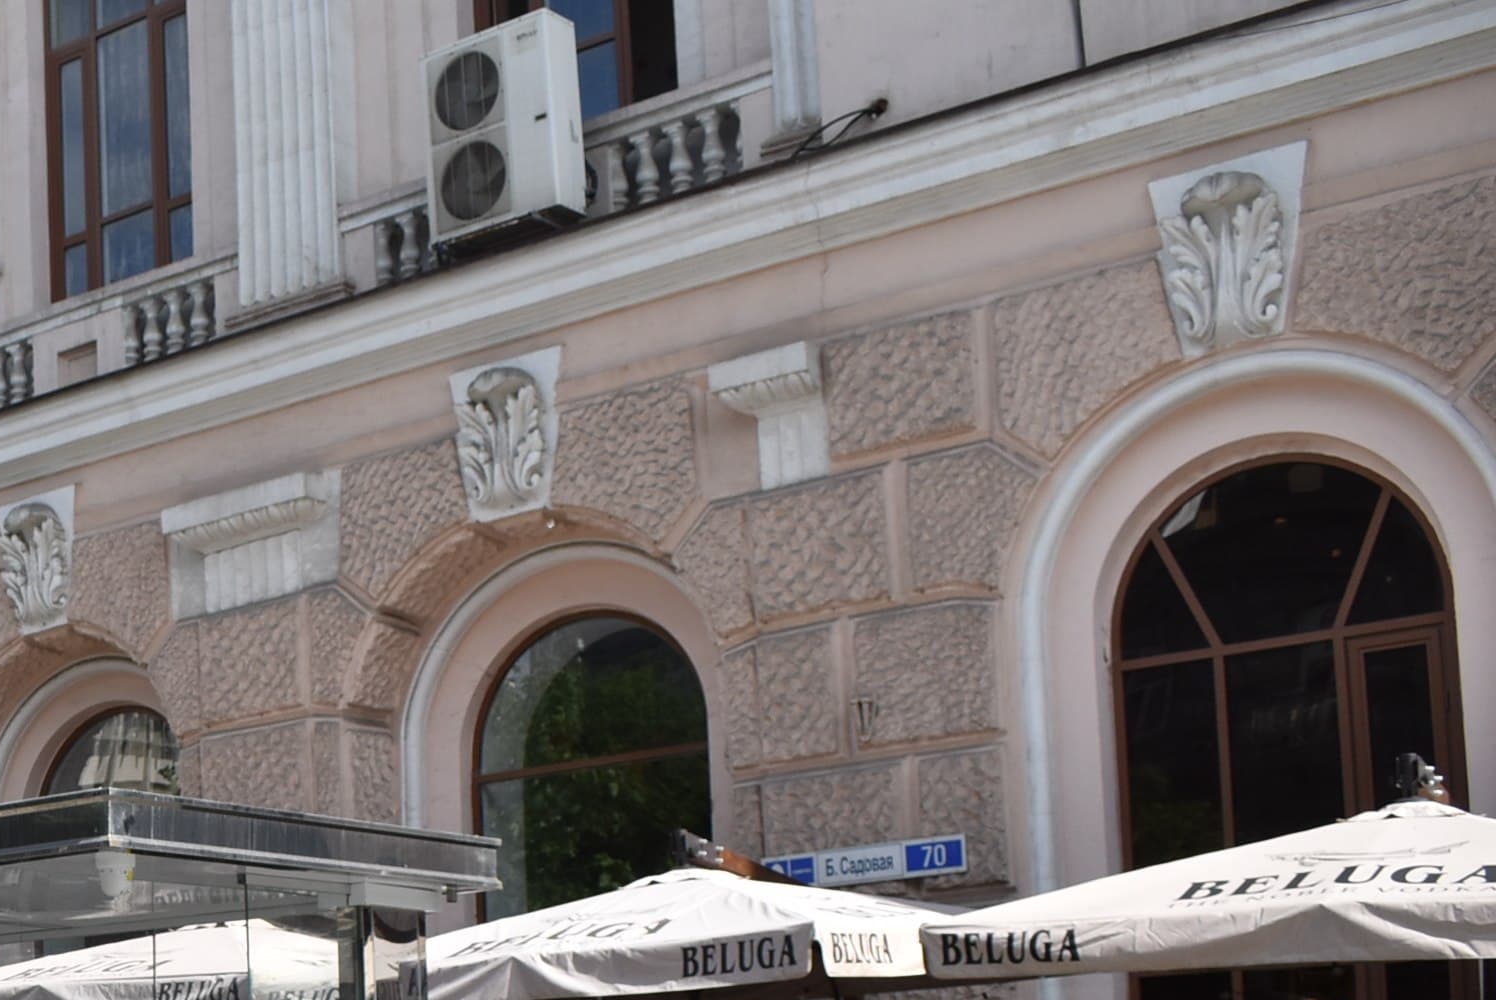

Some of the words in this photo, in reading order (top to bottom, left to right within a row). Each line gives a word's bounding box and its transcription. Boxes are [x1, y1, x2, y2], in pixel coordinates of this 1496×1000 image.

[825, 858, 837, 877] Б.
[840, 855, 894, 877] Садовая
[920, 844, 947, 867] 70
[681, 934, 797, 978] BELUGA
[830, 932, 893, 964] BELUGA
[941, 929, 1080, 966] BELUGA
